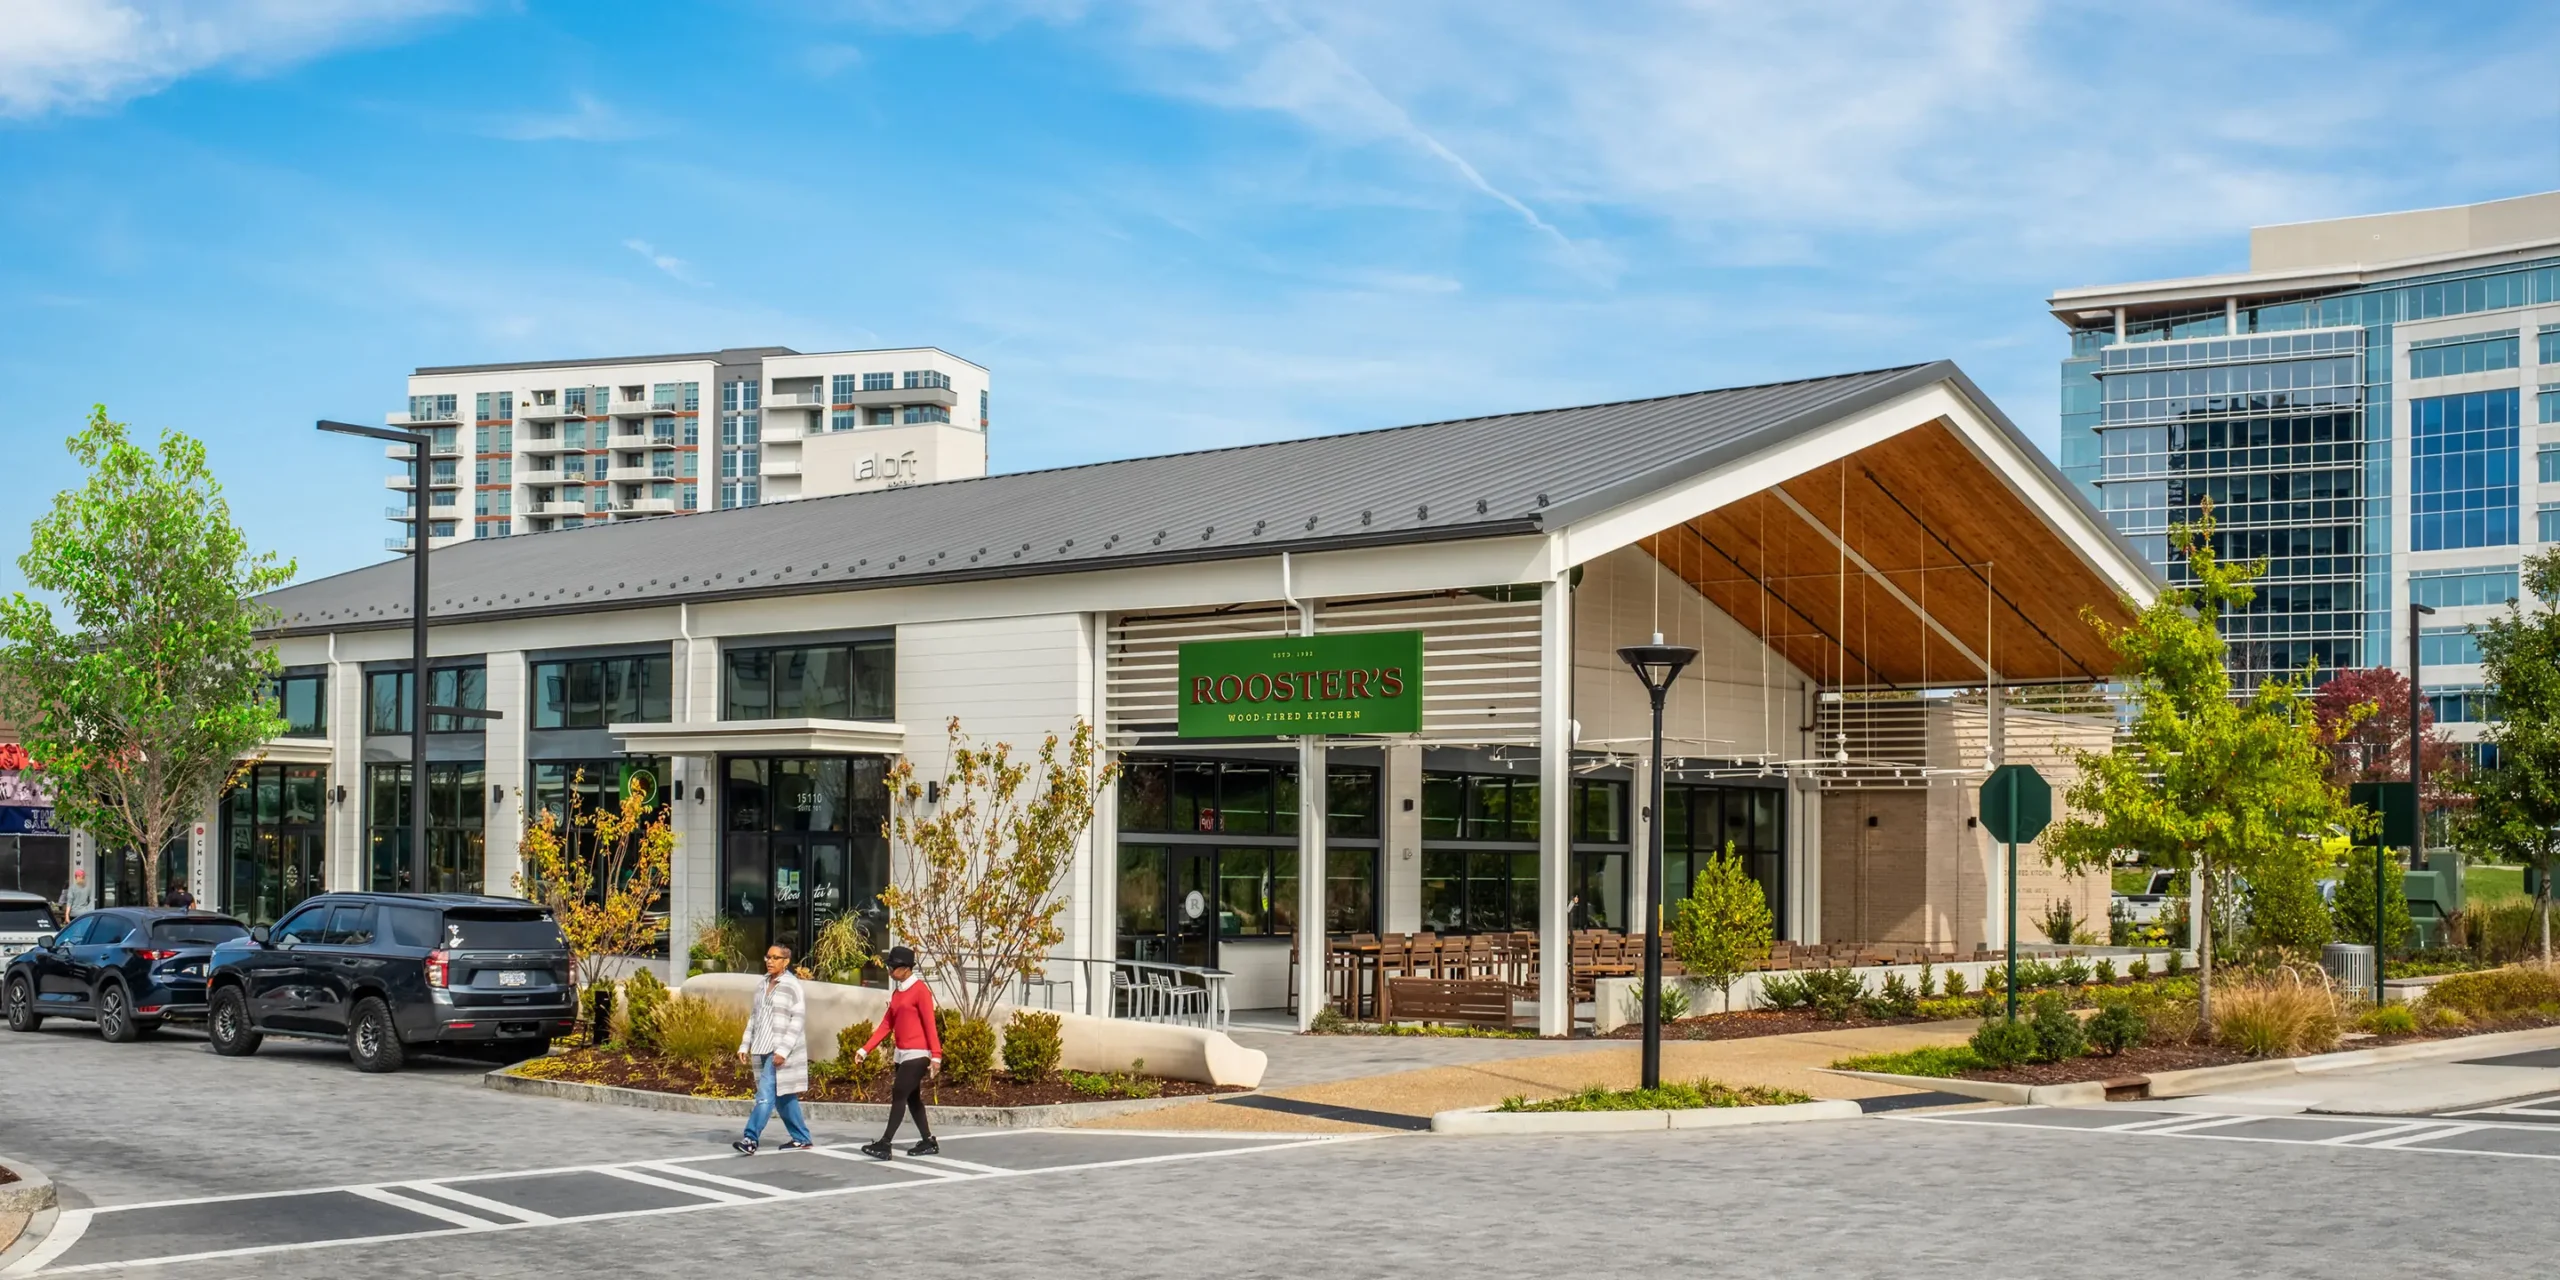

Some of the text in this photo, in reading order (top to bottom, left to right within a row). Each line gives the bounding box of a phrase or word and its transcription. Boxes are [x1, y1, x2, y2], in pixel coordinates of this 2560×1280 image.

[853, 450, 917, 482] aloft
[1190, 667, 1404, 704] ROOSTER'S
[1307, 710, 1361, 720] KITCHEN
[797, 793, 823, 803] 15110
[1190, 899, 1200, 910] R
